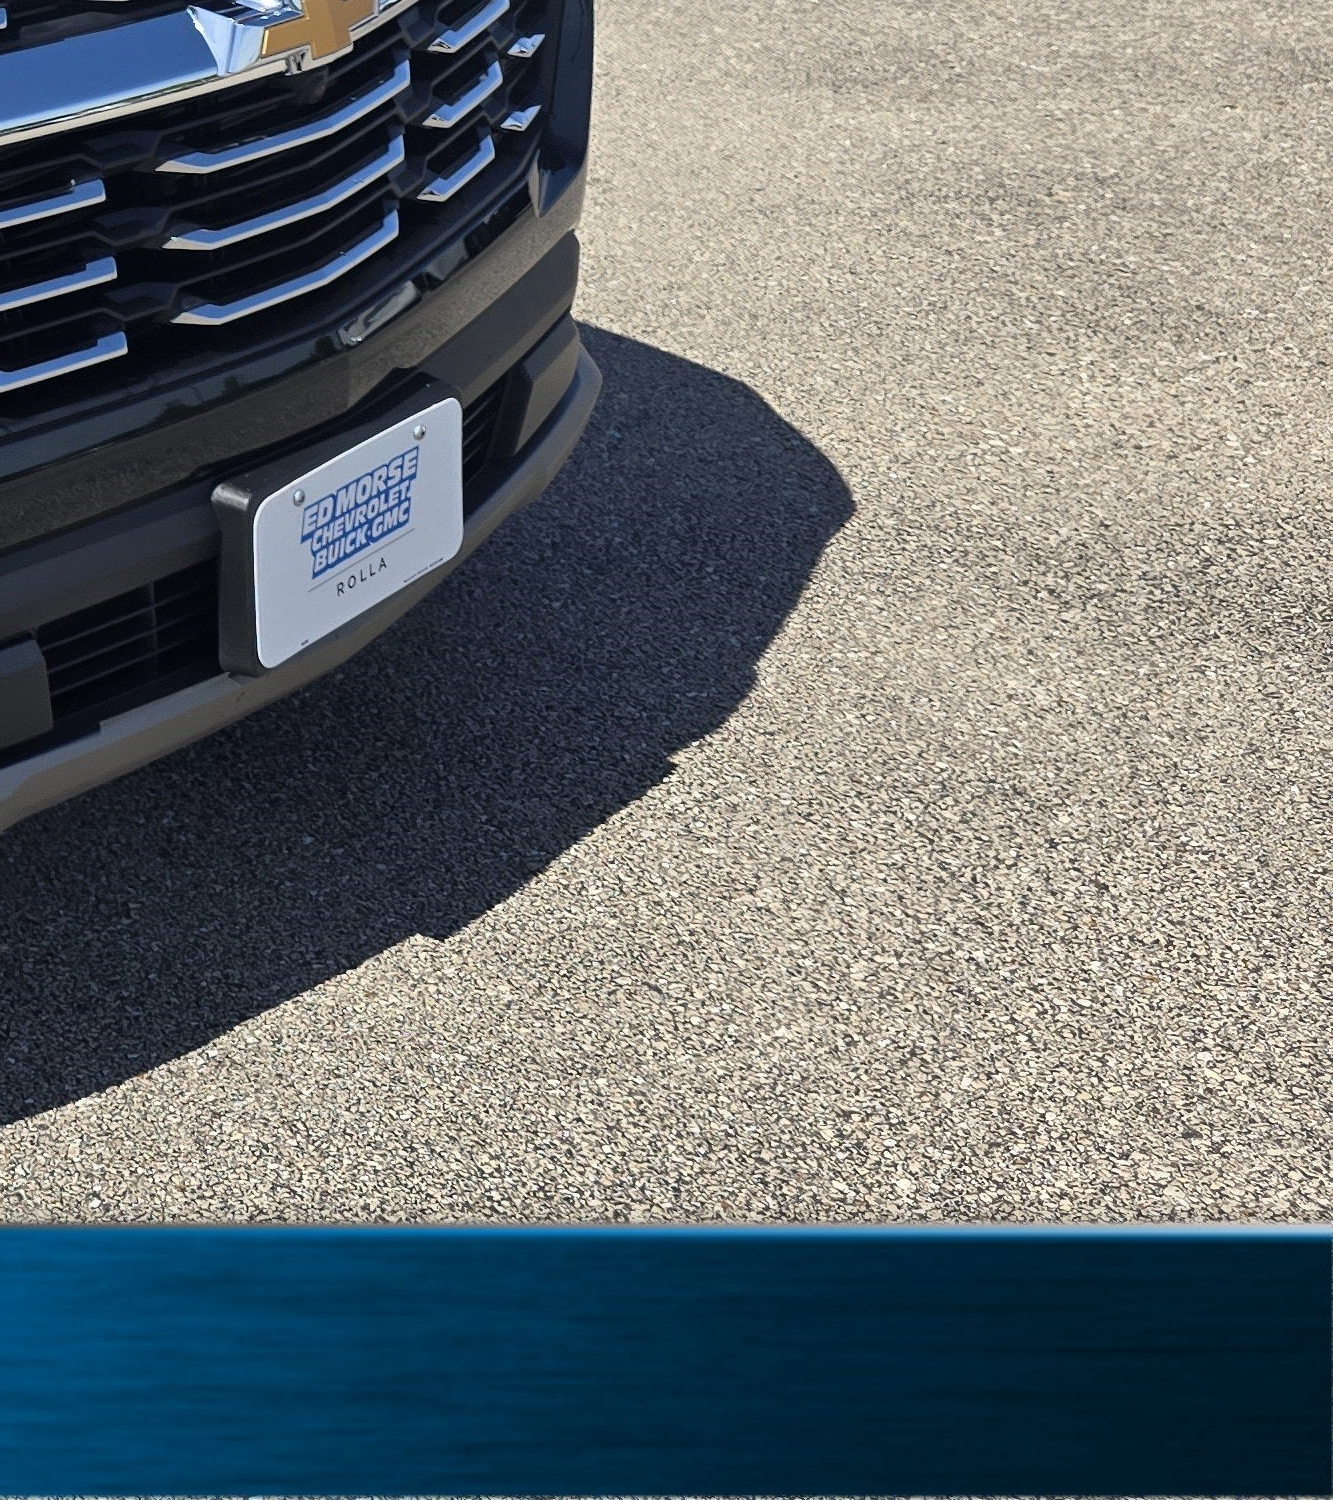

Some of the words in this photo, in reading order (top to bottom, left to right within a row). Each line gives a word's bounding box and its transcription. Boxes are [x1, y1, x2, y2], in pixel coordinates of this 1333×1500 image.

[301, 493, 335, 541] ED
[336, 447, 418, 518] MORSE
[311, 479, 411, 553] CHEVROLET
[336, 557, 388, 597] ROLLA
